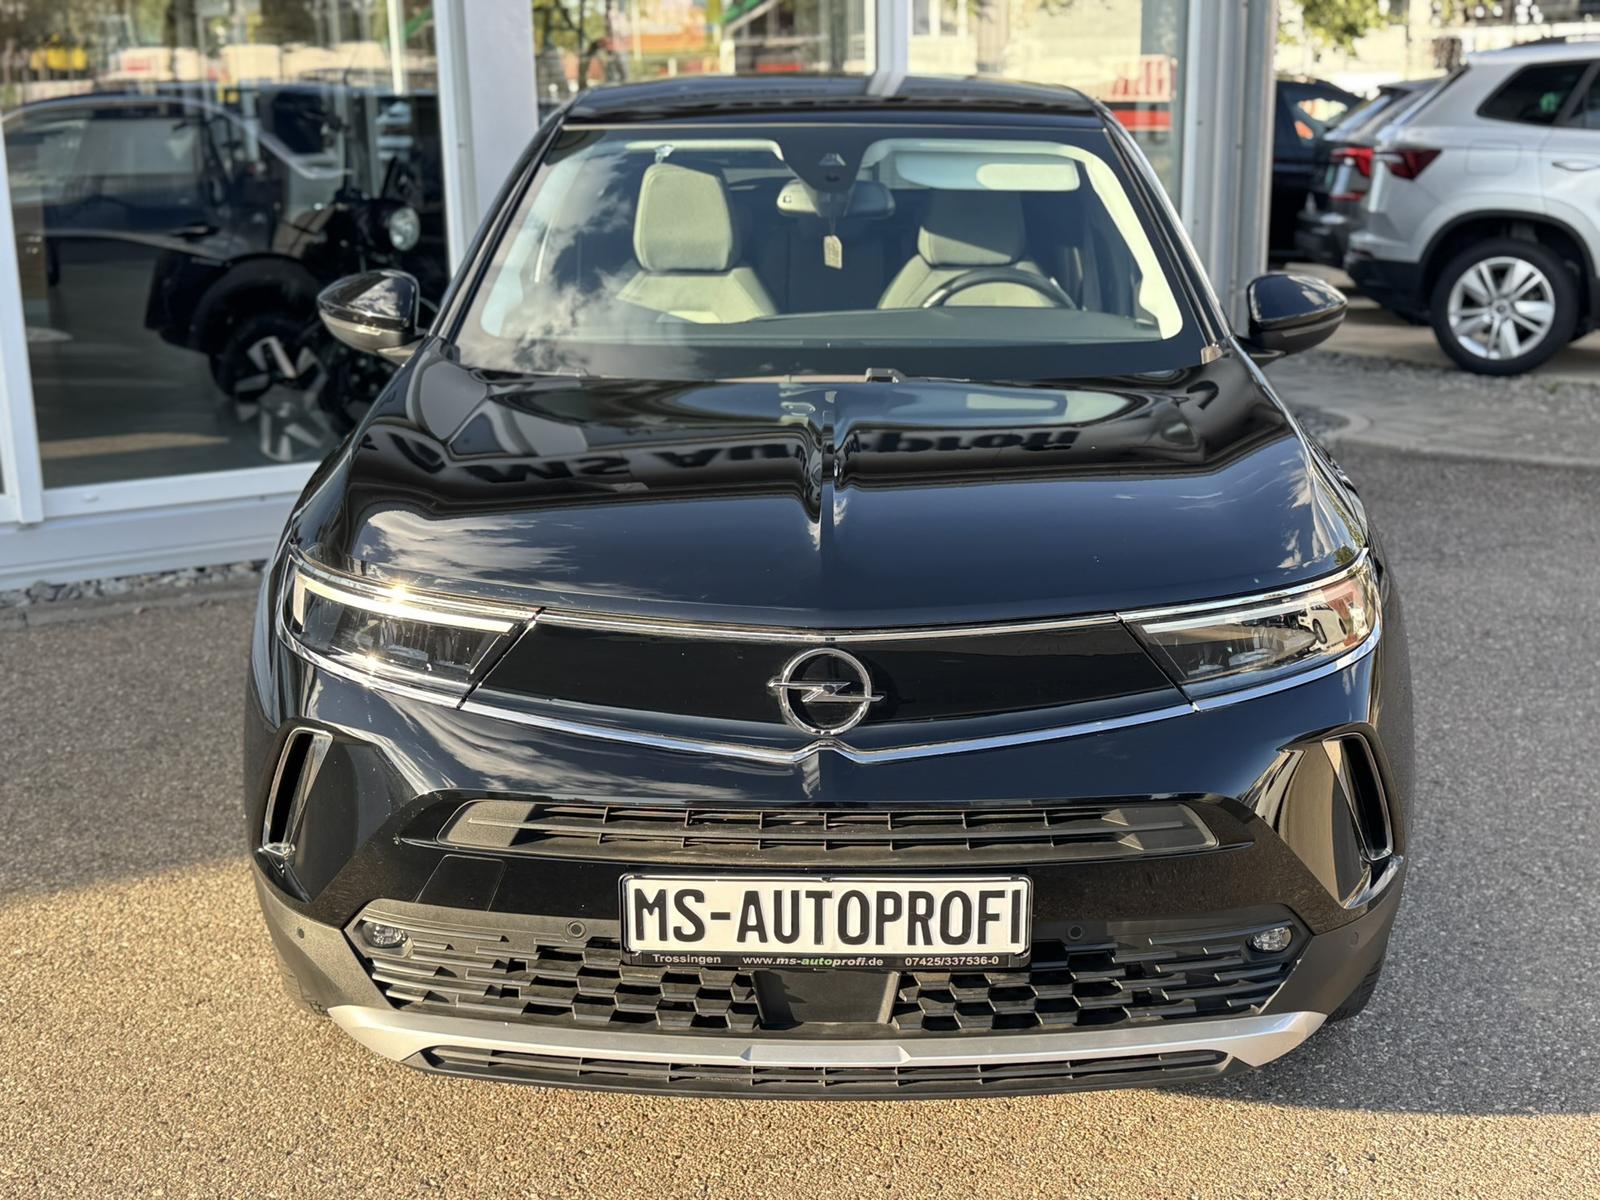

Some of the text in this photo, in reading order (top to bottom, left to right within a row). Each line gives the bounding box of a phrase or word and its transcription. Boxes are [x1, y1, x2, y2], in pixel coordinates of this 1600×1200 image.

[634, 887, 1022, 946] MS-AUTOPROFI
[652, 953, 1000, 968] Trossingen www.ms-autoprofi.de 07425/337536-0
